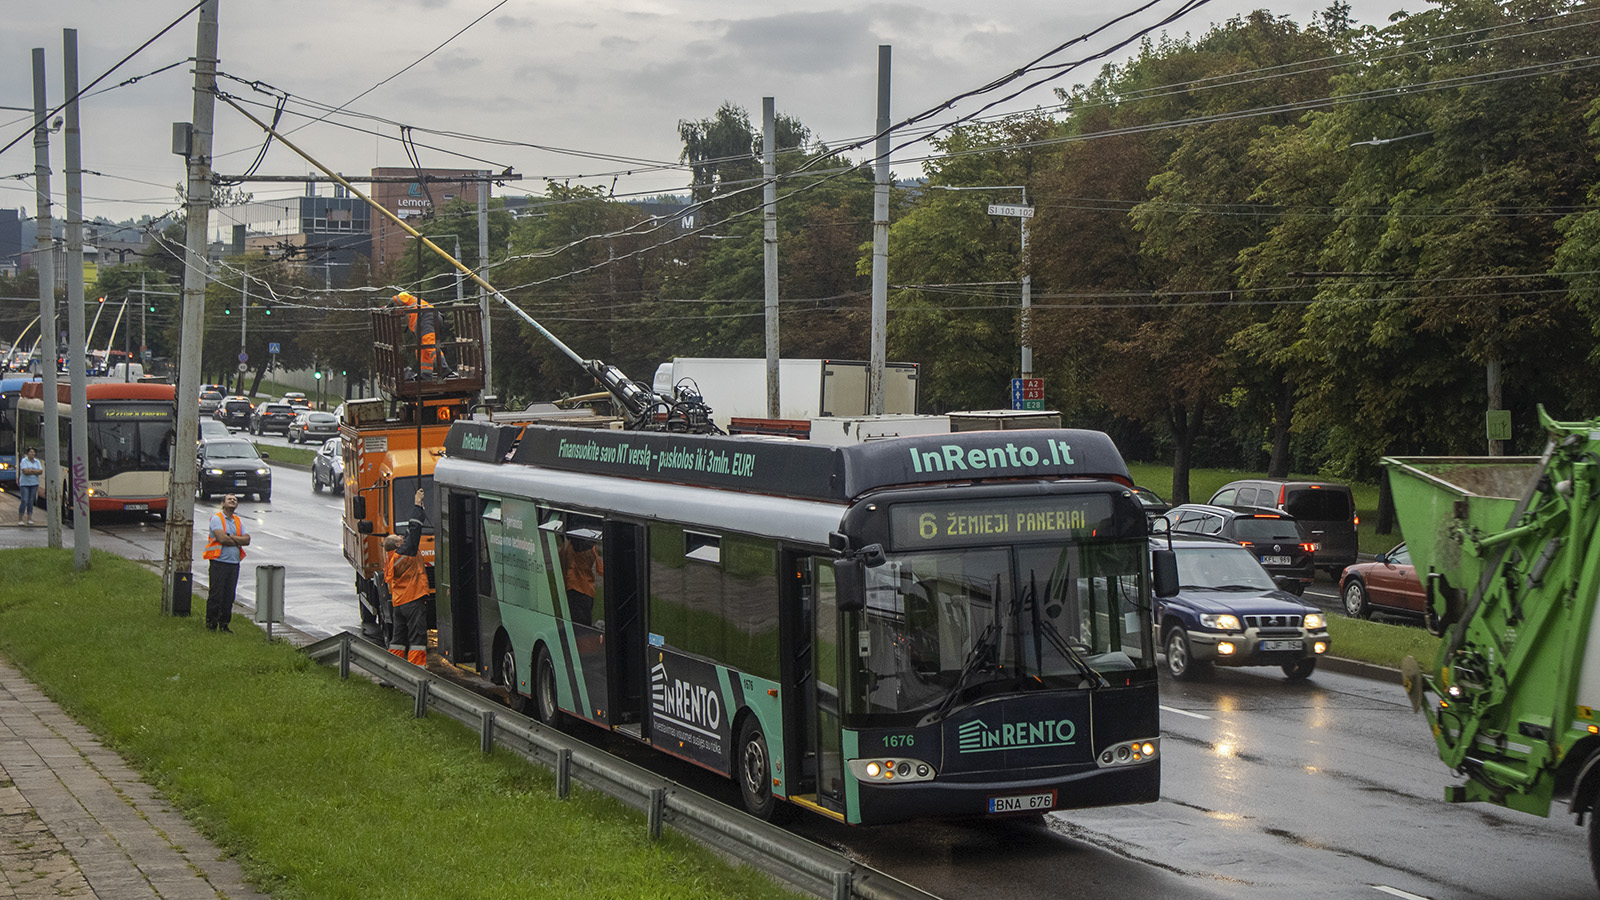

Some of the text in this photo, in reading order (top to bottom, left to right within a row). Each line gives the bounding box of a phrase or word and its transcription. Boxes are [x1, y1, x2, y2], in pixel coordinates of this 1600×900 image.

[1000, 207, 1016, 216] 103
[1018, 208, 1034, 217] 102
[1028, 380, 1039, 388] A2
[1026, 401, 1041, 409] E28
[558, 438, 600, 462] Finansuokite
[600, 445, 617, 463] savo
[616, 443, 630, 464] NT
[628, 444, 651, 471] verslą
[658, 446, 694, 473] paskolos
[694, 448, 707, 471] iki
[707, 450, 731, 475] 3mln.
[731, 452, 756, 477] EUR!
[909, 438, 1075, 473] InRento.lt
[919, 509, 1086, 540] 6 ŽEMIEJI PANERIAI
[743, 679, 754, 691] 1676
[882, 734, 915, 748] 1676
[996, 795, 1052, 811] BNA 676
